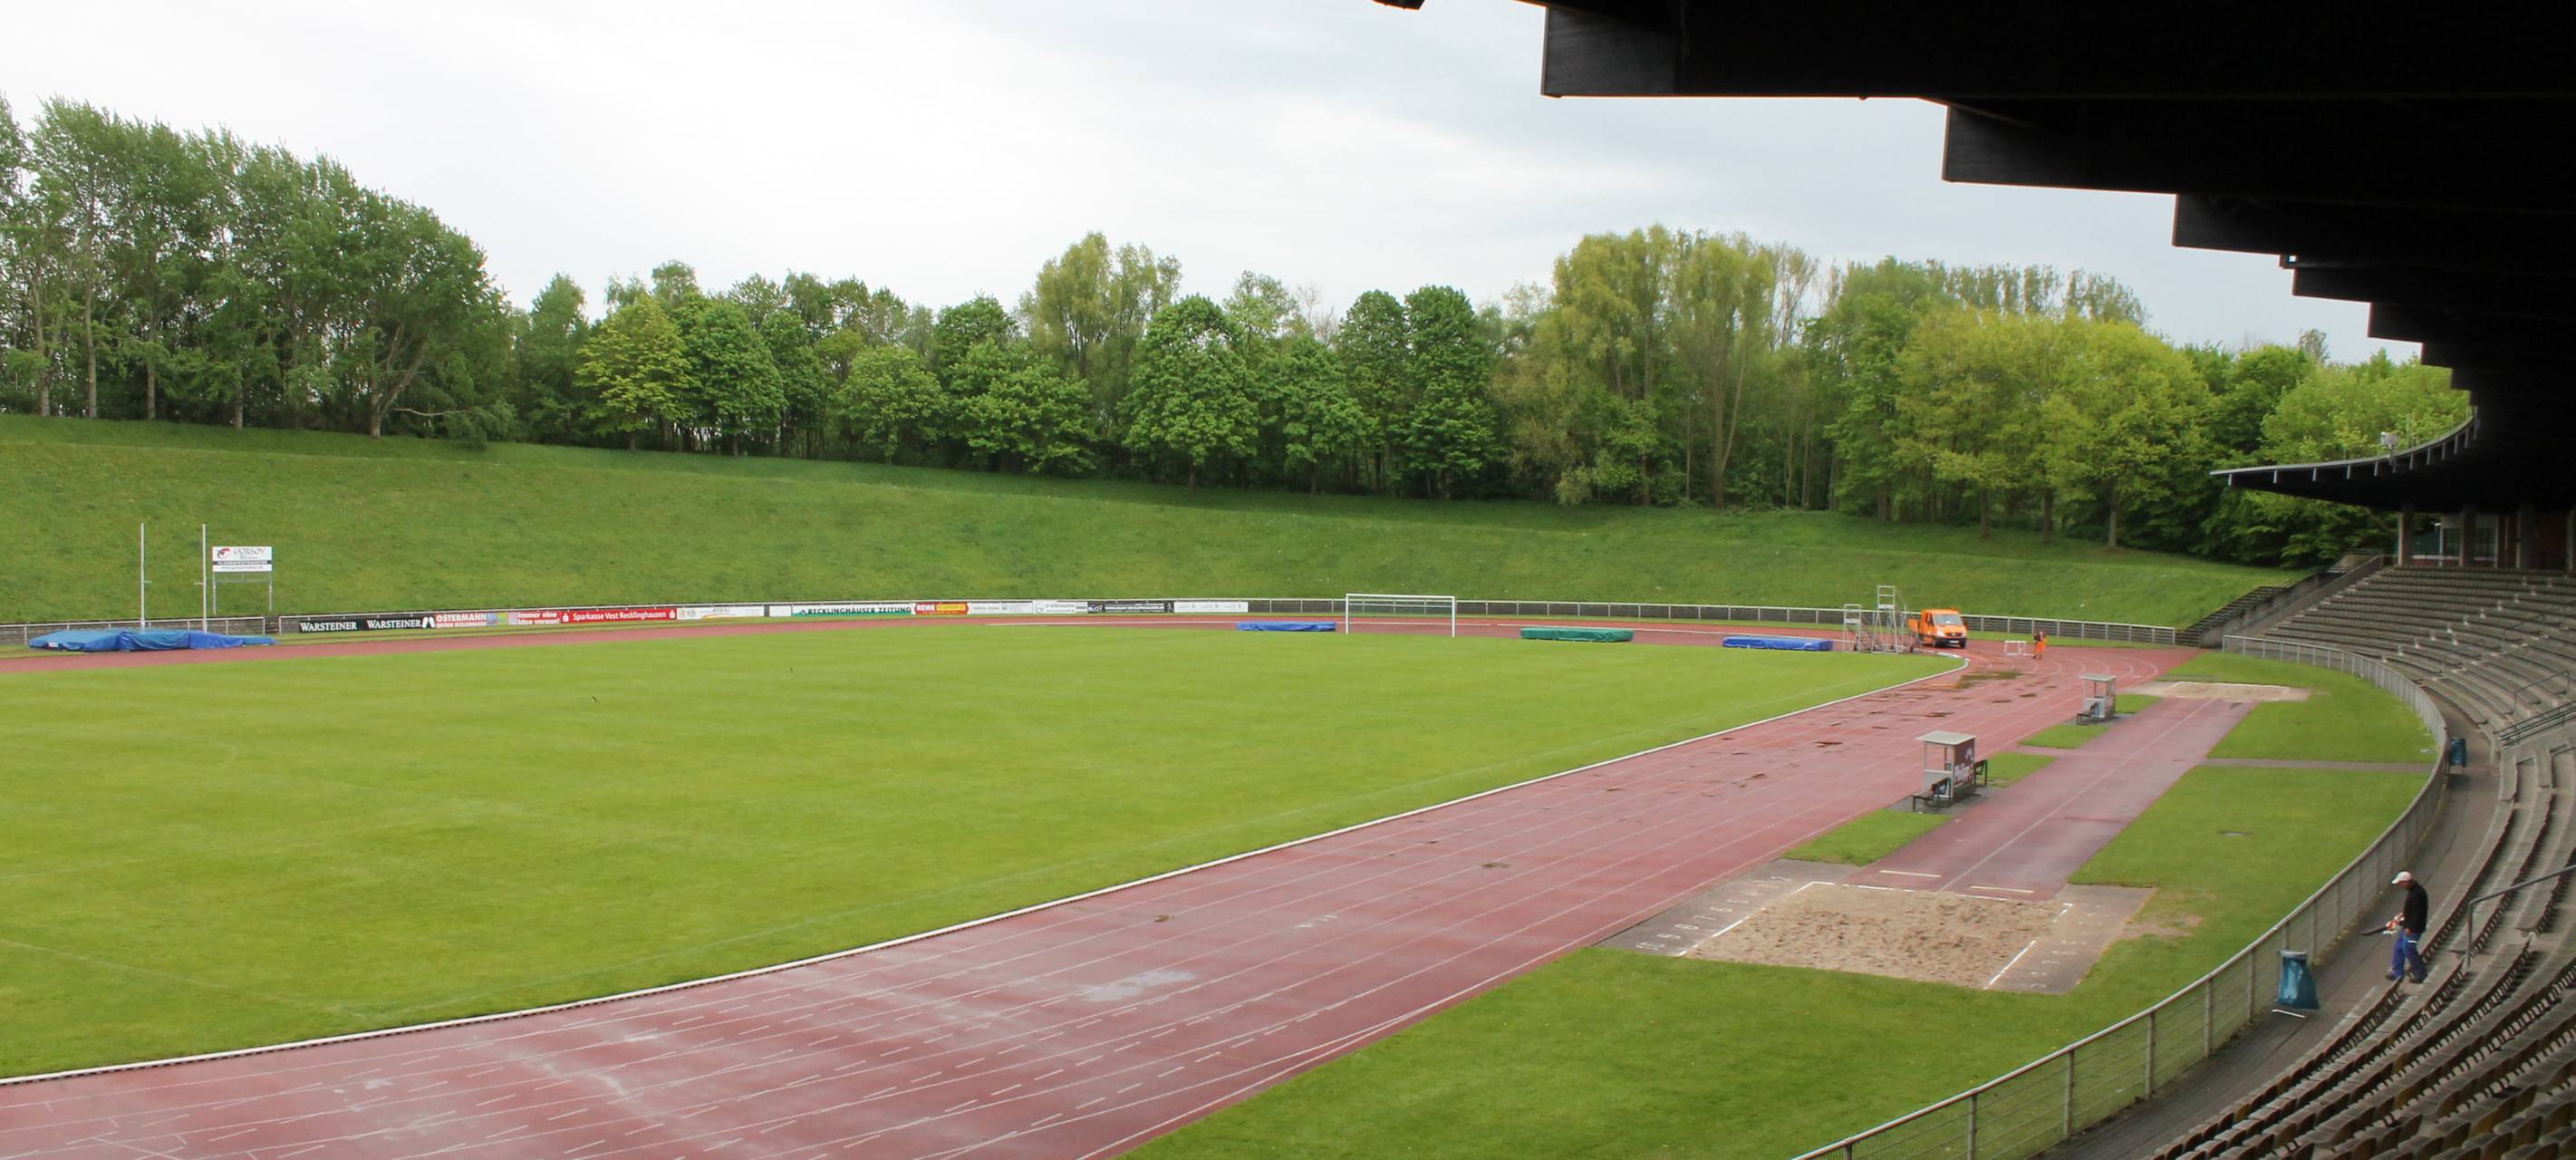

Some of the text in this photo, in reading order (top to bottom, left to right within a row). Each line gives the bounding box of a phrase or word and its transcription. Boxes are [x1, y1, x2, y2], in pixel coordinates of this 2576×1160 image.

[436, 613, 487, 622] OSTERMANN
[573, 611, 667, 622] Sparkasse Vest Recklinghausen
[300, 622, 357, 632] WARSTEINER
[366, 619, 421, 629] WARSTEINER
